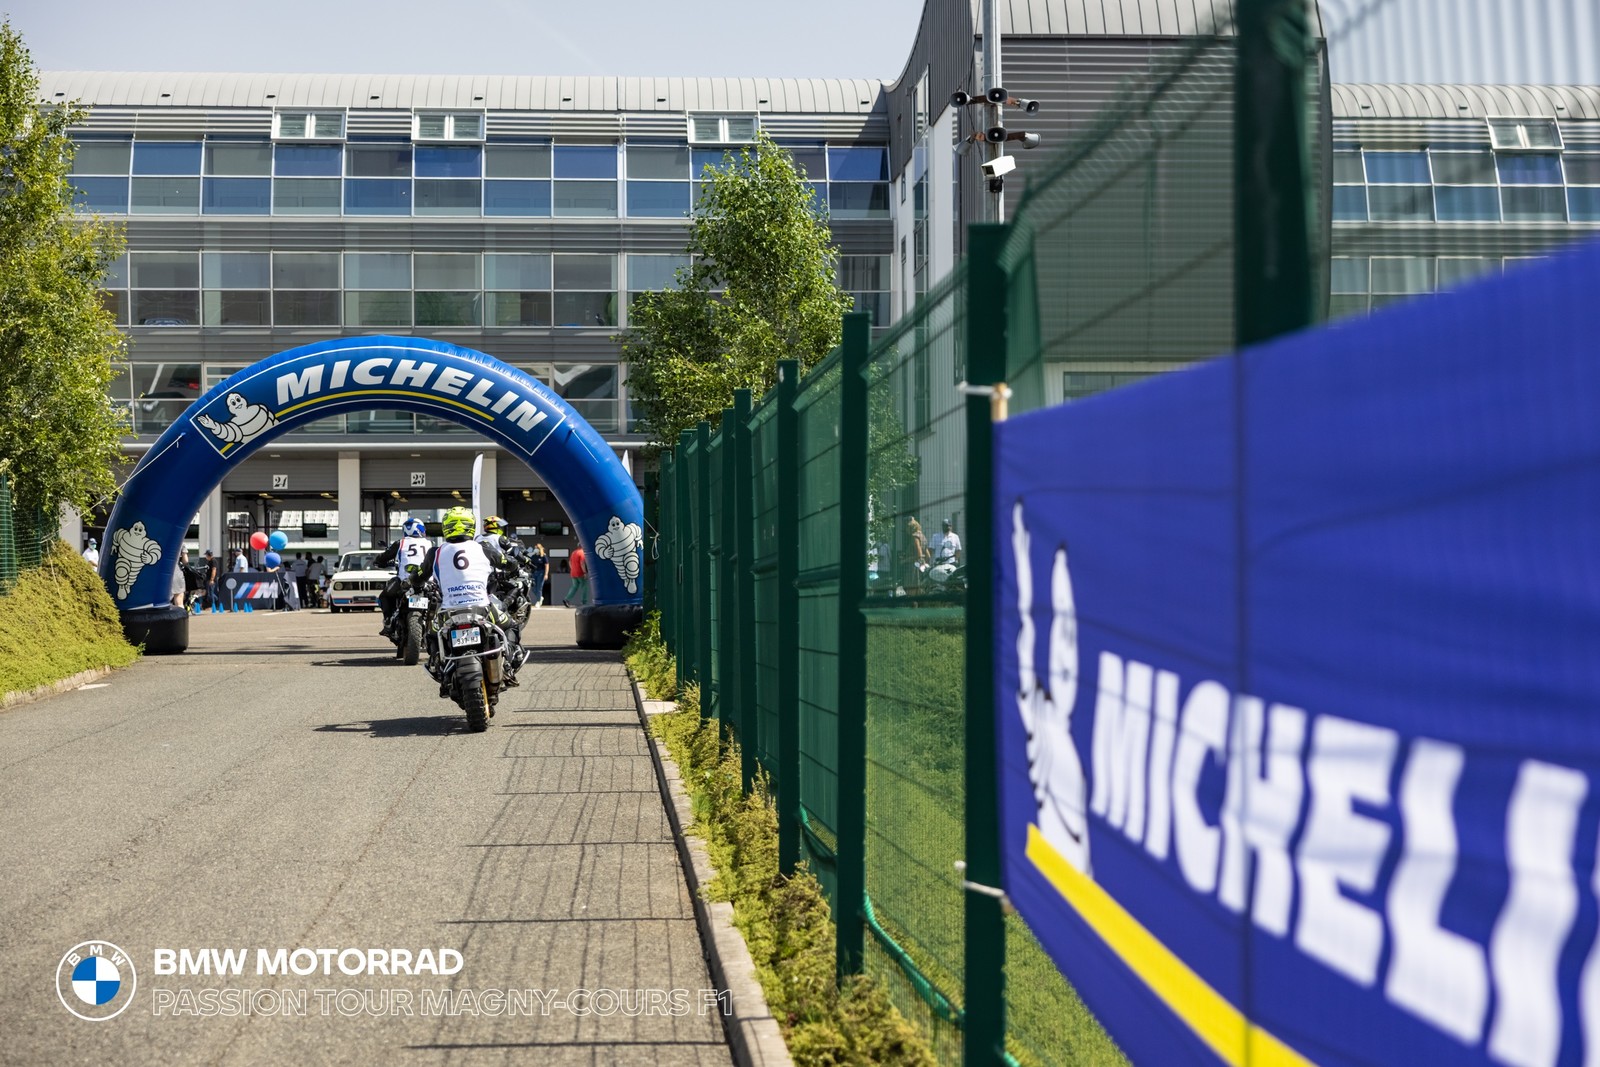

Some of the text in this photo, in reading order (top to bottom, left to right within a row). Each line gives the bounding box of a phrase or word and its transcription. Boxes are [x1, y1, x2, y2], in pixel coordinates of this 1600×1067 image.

[276, 357, 547, 432] MICHELIN
[412, 474, 425, 485] 23
[453, 549, 470, 570] 6
[1090, 650, 1600, 1067] MICHELI
